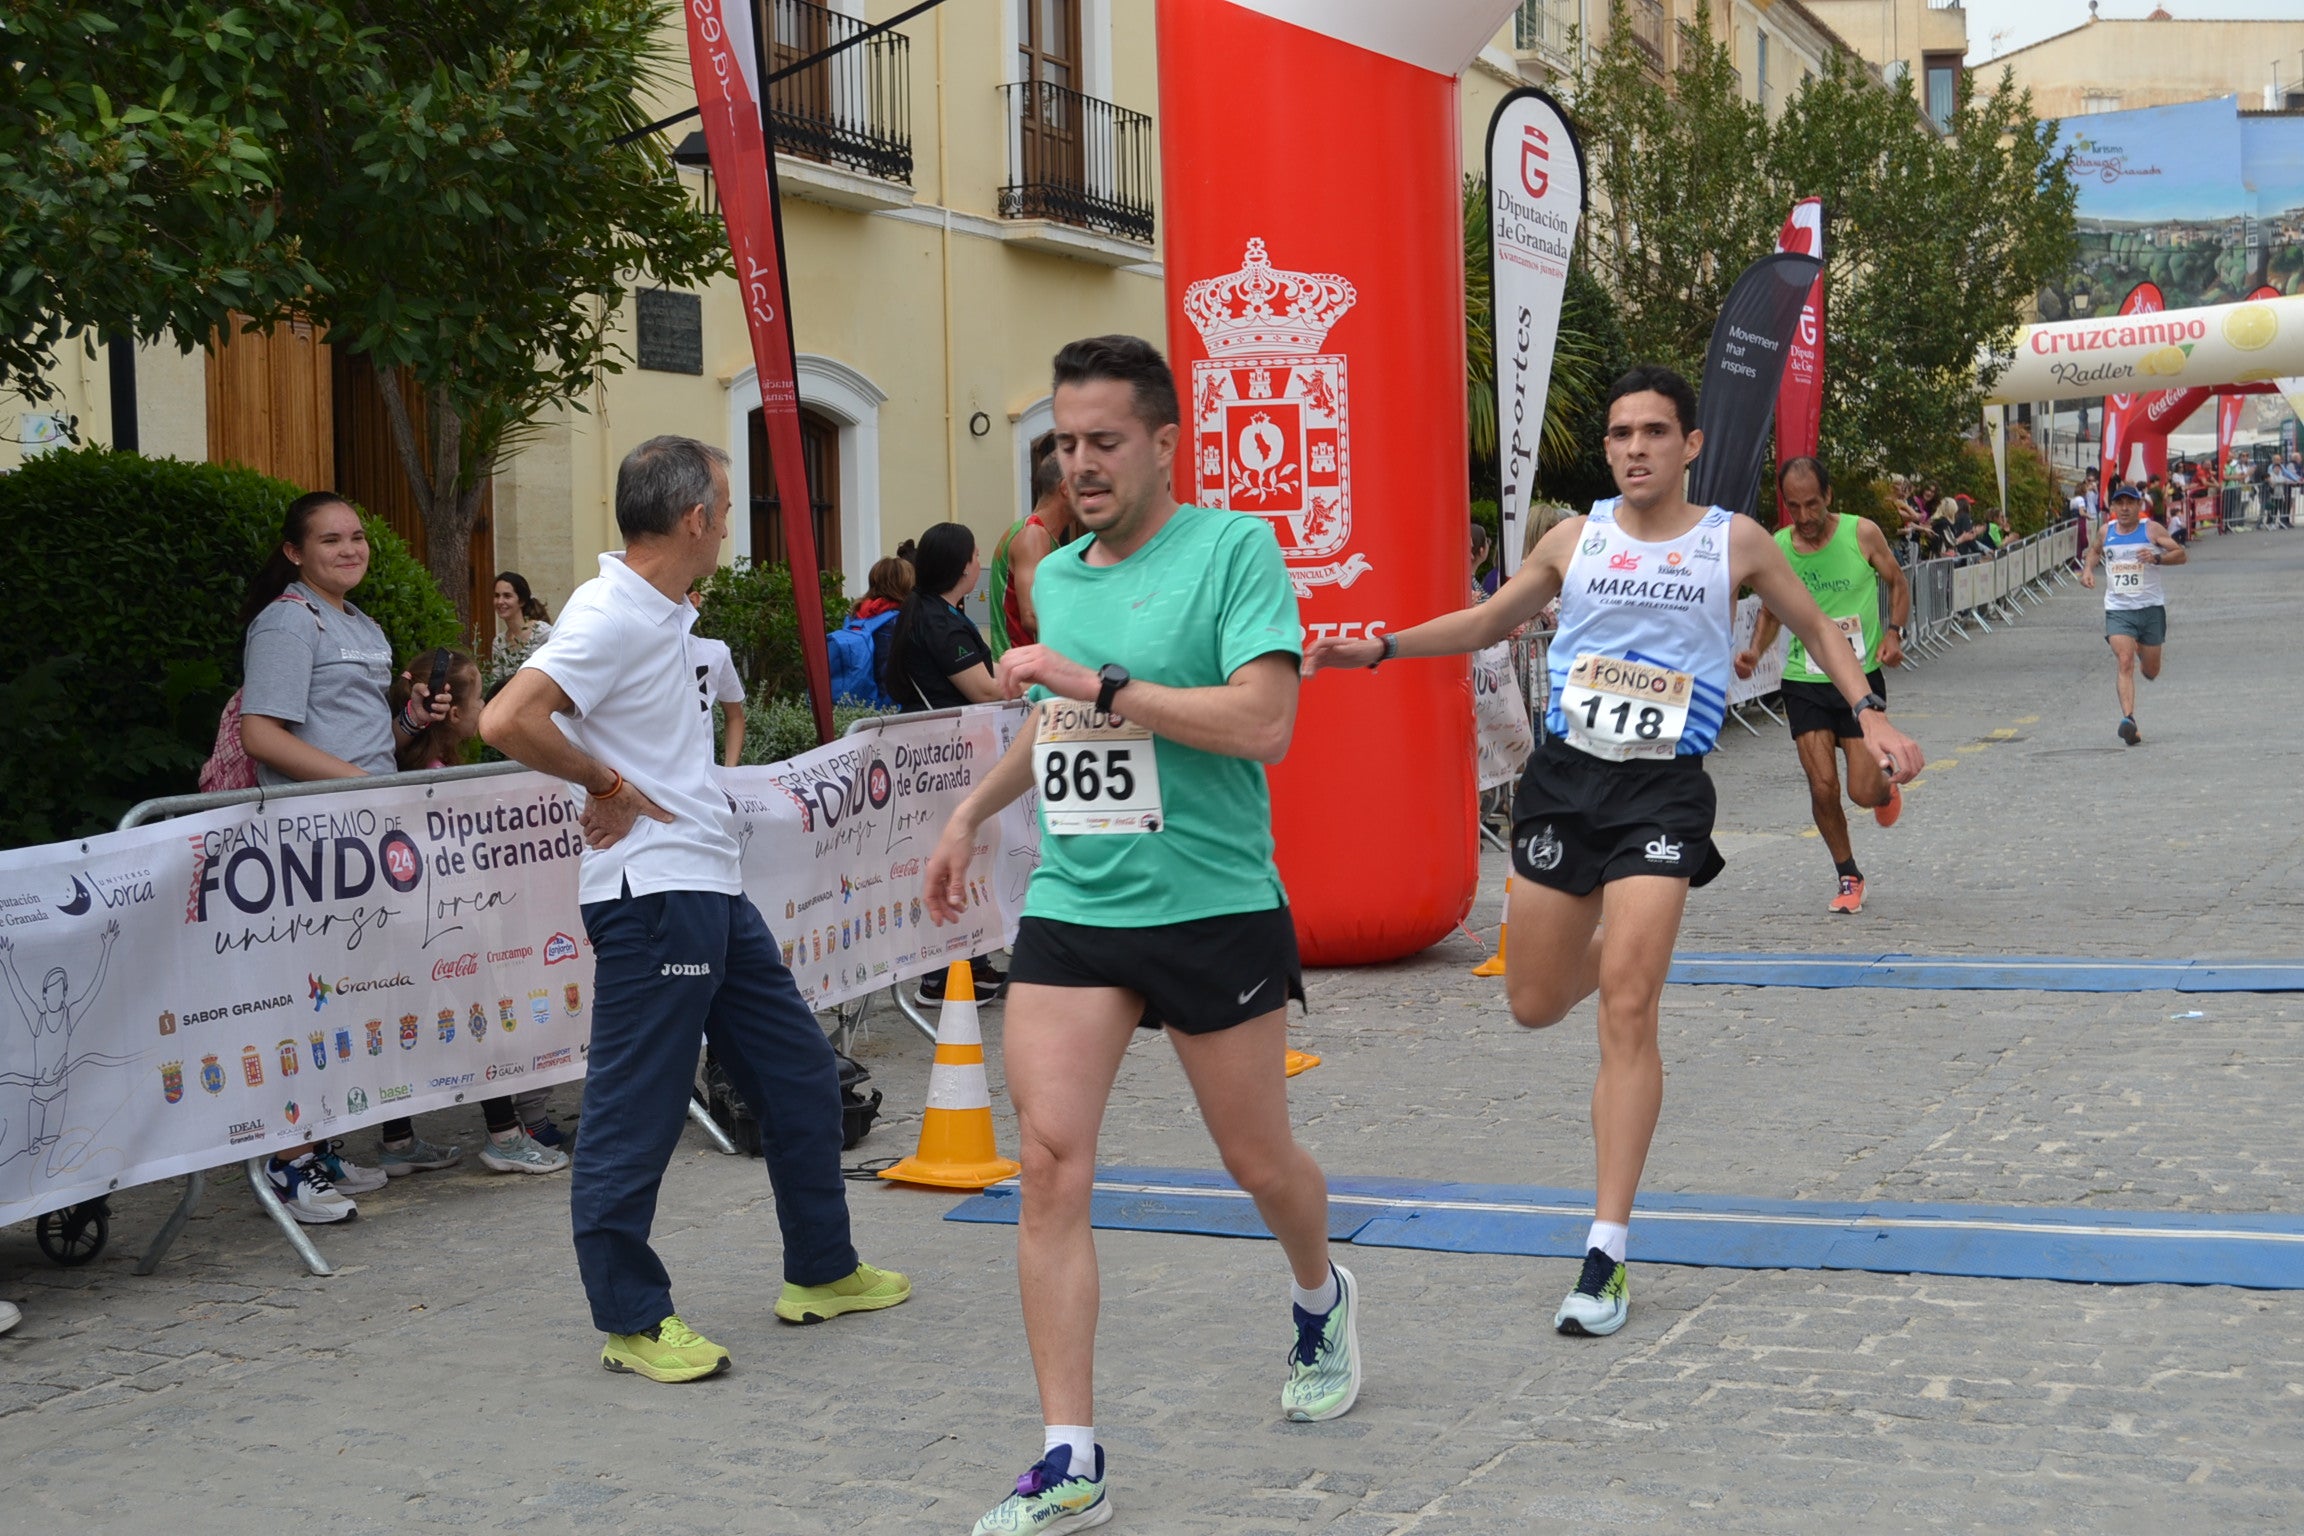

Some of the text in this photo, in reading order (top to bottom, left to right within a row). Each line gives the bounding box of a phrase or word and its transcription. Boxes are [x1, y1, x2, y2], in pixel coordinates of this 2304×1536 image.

[1498, 188, 1568, 235] Diputación
[1498, 217, 1568, 259] de Granada
[1725, 341, 1746, 358] that
[1729, 325, 1779, 352] Movement
[2031, 319, 2206, 356] Cruzcampo
[1720, 356, 1757, 379] inspires
[2050, 360, 2137, 387] Radler
[1586, 578, 1707, 604] MARACENA
[2114, 573, 2139, 587] 736
[1595, 665, 1667, 693] FONDO
[1580, 695, 1665, 740] 118
[895, 736, 973, 775] Diputación
[778, 763, 830, 790] GRAN
[872, 773, 886, 795] 24
[897, 764, 971, 797] de Granada
[1044, 749, 1135, 802] 865
[203, 808, 402, 859] GRAN PREMIO DE
[426, 794, 579, 846] Diputación
[388, 849, 414, 875] 24
[435, 828, 583, 877] de Granada
[84, 870, 156, 909] Lorca
[99, 868, 151, 886] UNIVERSO
[197, 829, 424, 923] FONDO
[6, 909, 49, 926] Granada
[215, 853, 517, 955] universo Lorca
[486, 945, 533, 963] Cruzcampo
[335, 971, 416, 996] Granada
[183, 994, 294, 1026] SABOR GRANADA
[229, 1118, 265, 1135] IDEAL
[1032, 1507, 1051, 1525] new
